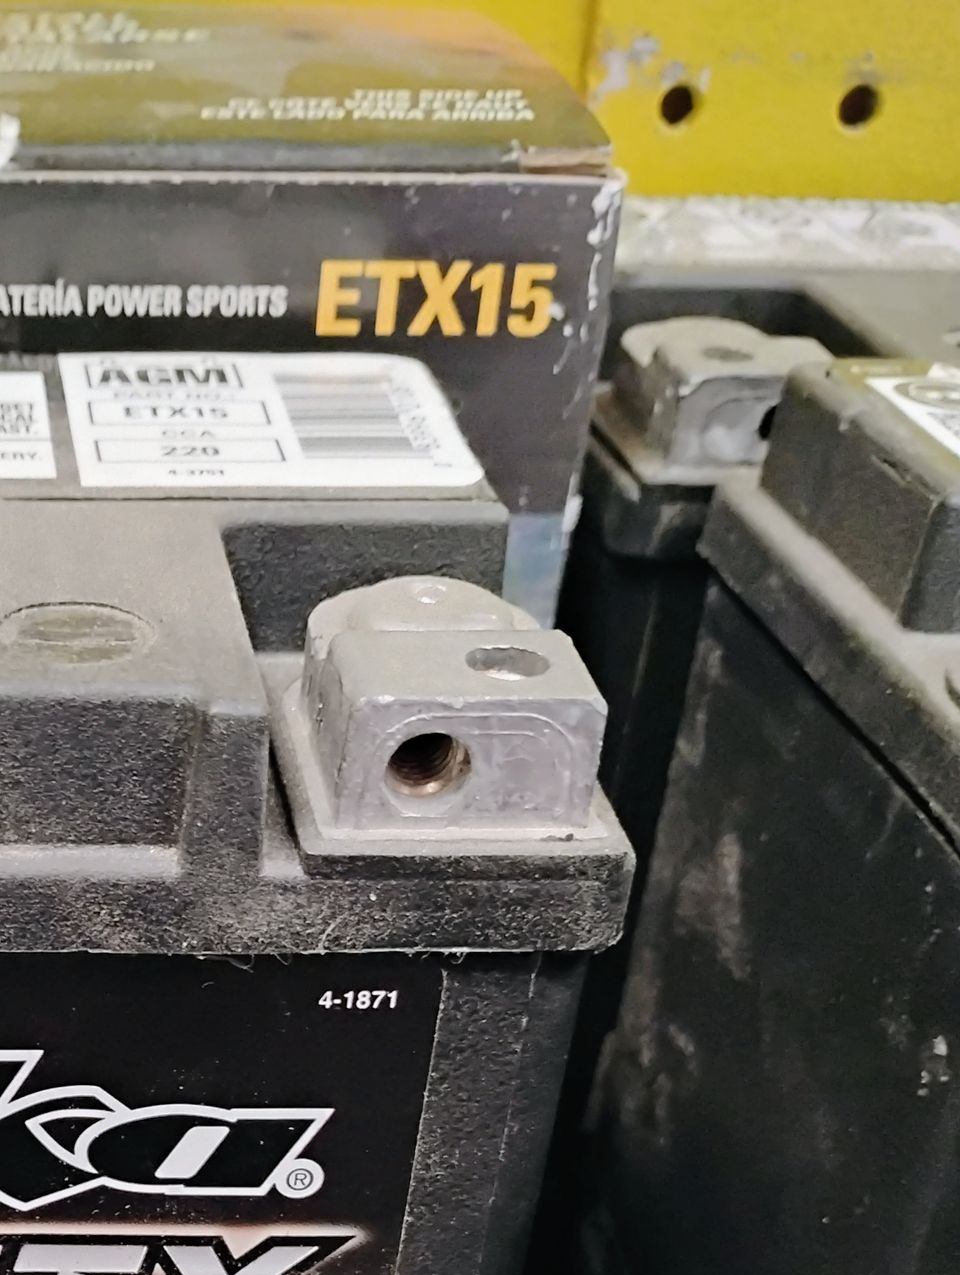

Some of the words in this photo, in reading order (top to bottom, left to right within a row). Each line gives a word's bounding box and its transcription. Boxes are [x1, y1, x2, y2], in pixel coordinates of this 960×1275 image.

[87, 284, 182, 317] POWER
[186, 284, 289, 317] SPORTS
[315, 259, 558, 338] ETX15
[98, 367, 229, 384] AGM
[124, 406, 229, 419] ETX15
[161, 446, 221, 457] 220
[318, 990, 400, 1010] 4-1871
